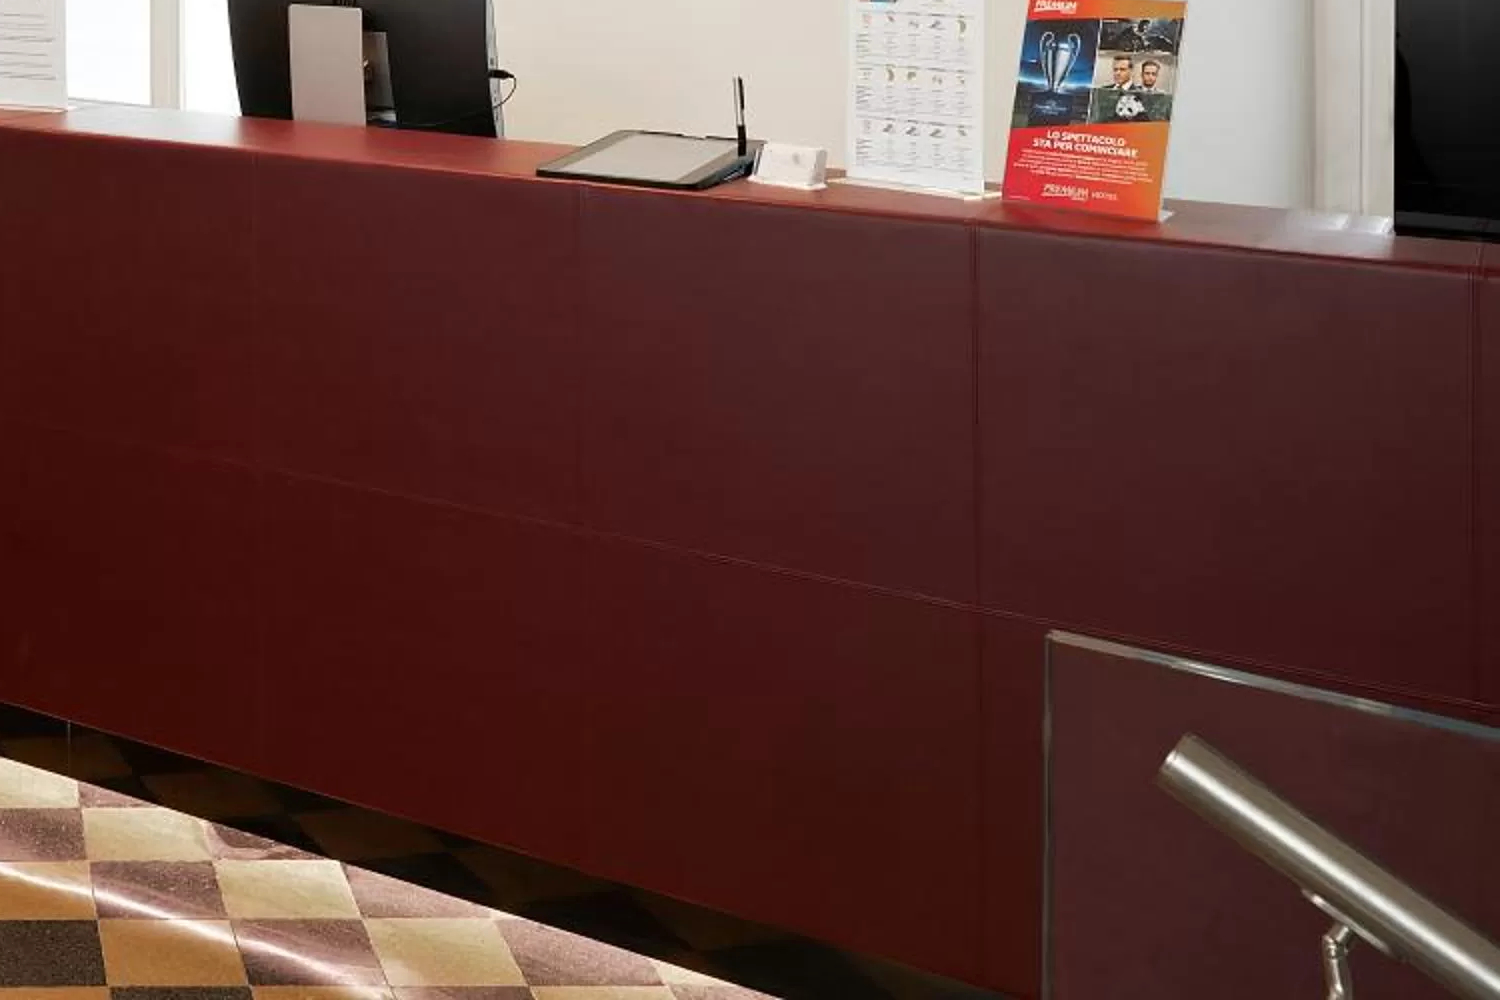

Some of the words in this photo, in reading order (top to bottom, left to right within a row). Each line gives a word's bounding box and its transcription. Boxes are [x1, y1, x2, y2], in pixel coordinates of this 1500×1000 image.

[1046, 129, 1060, 139] LO
[1062, 131, 1126, 147] SPETTACOLO
[1032, 138, 1051, 148] STA
[1053, 140, 1073, 151] PER
[1074, 143, 1139, 158] COMINCIARE
